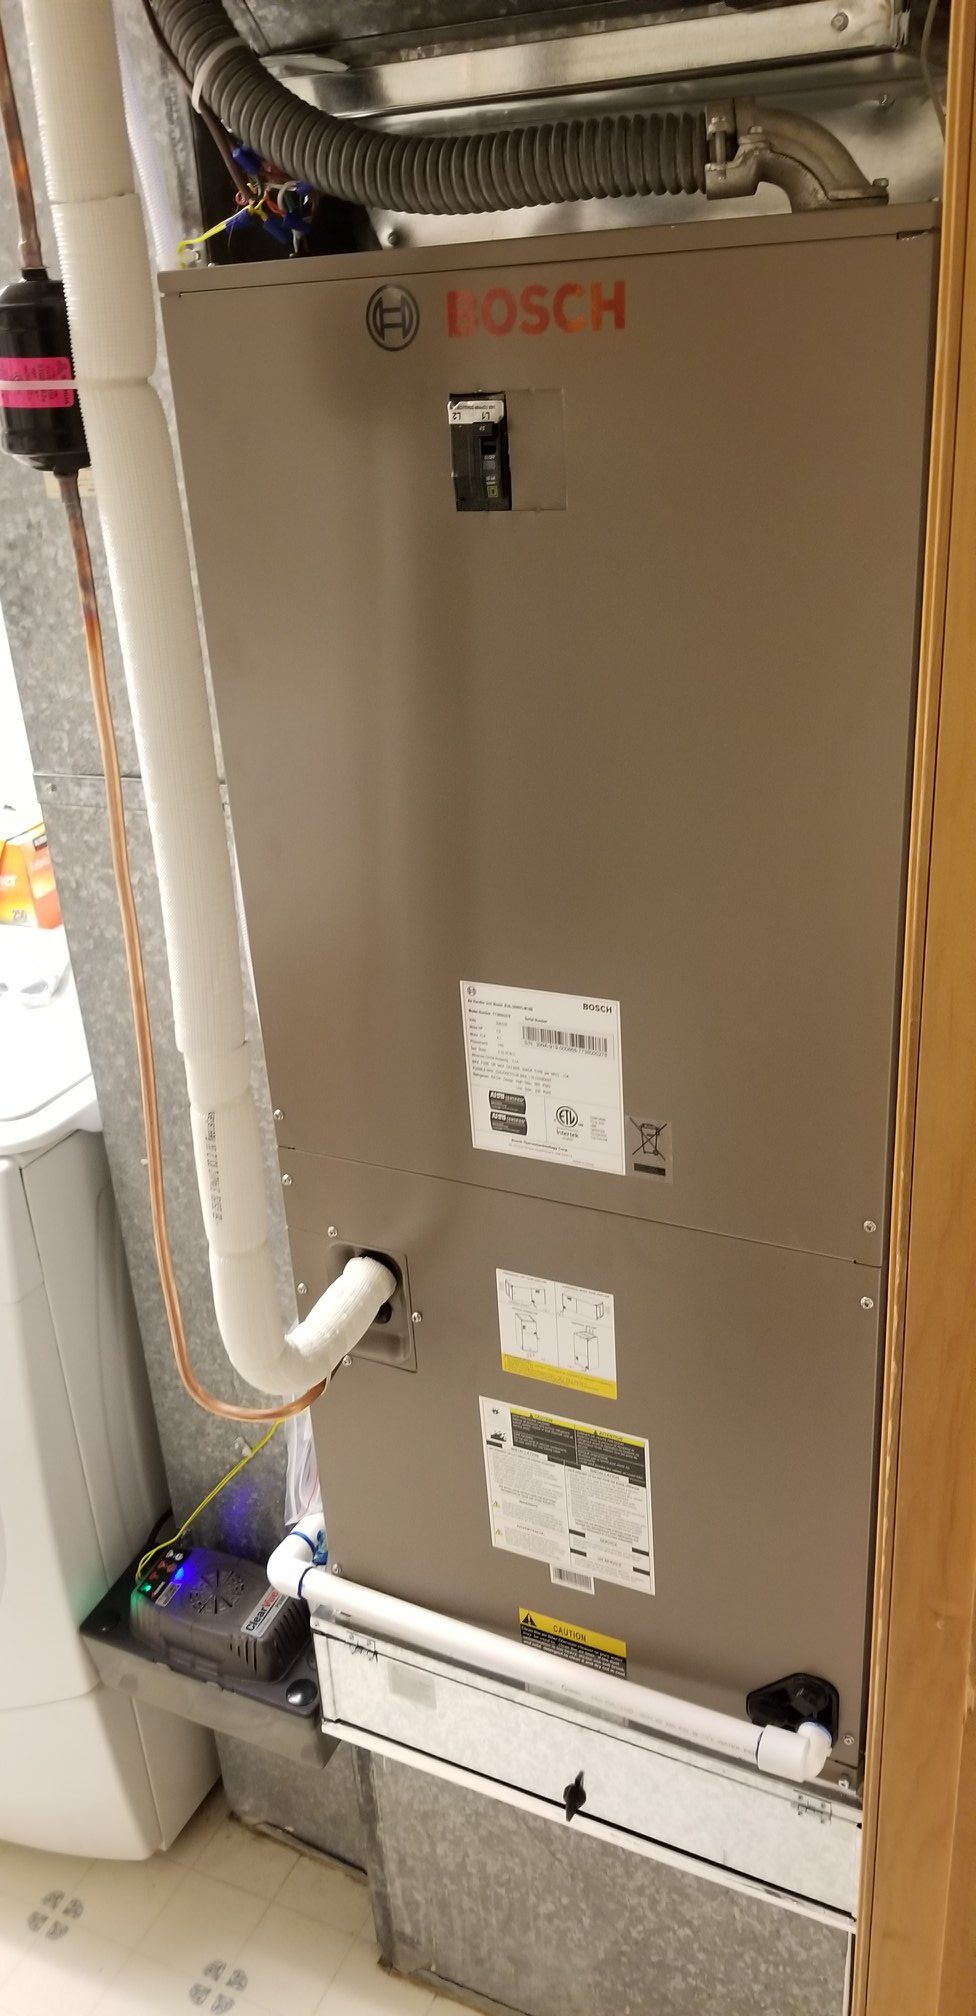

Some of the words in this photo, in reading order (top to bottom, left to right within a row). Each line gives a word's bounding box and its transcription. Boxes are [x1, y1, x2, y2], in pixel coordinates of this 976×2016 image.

[447, 279, 626, 341] BOSCH
[452, 412, 461, 421] L2
[481, 412, 491, 421] L1
[582, 1002, 612, 1013] BOSCH
[558, 1107, 576, 1126] ETL
[556, 1129, 579, 1139] Intertek
[552, 1624, 586, 1643] CAUTION
